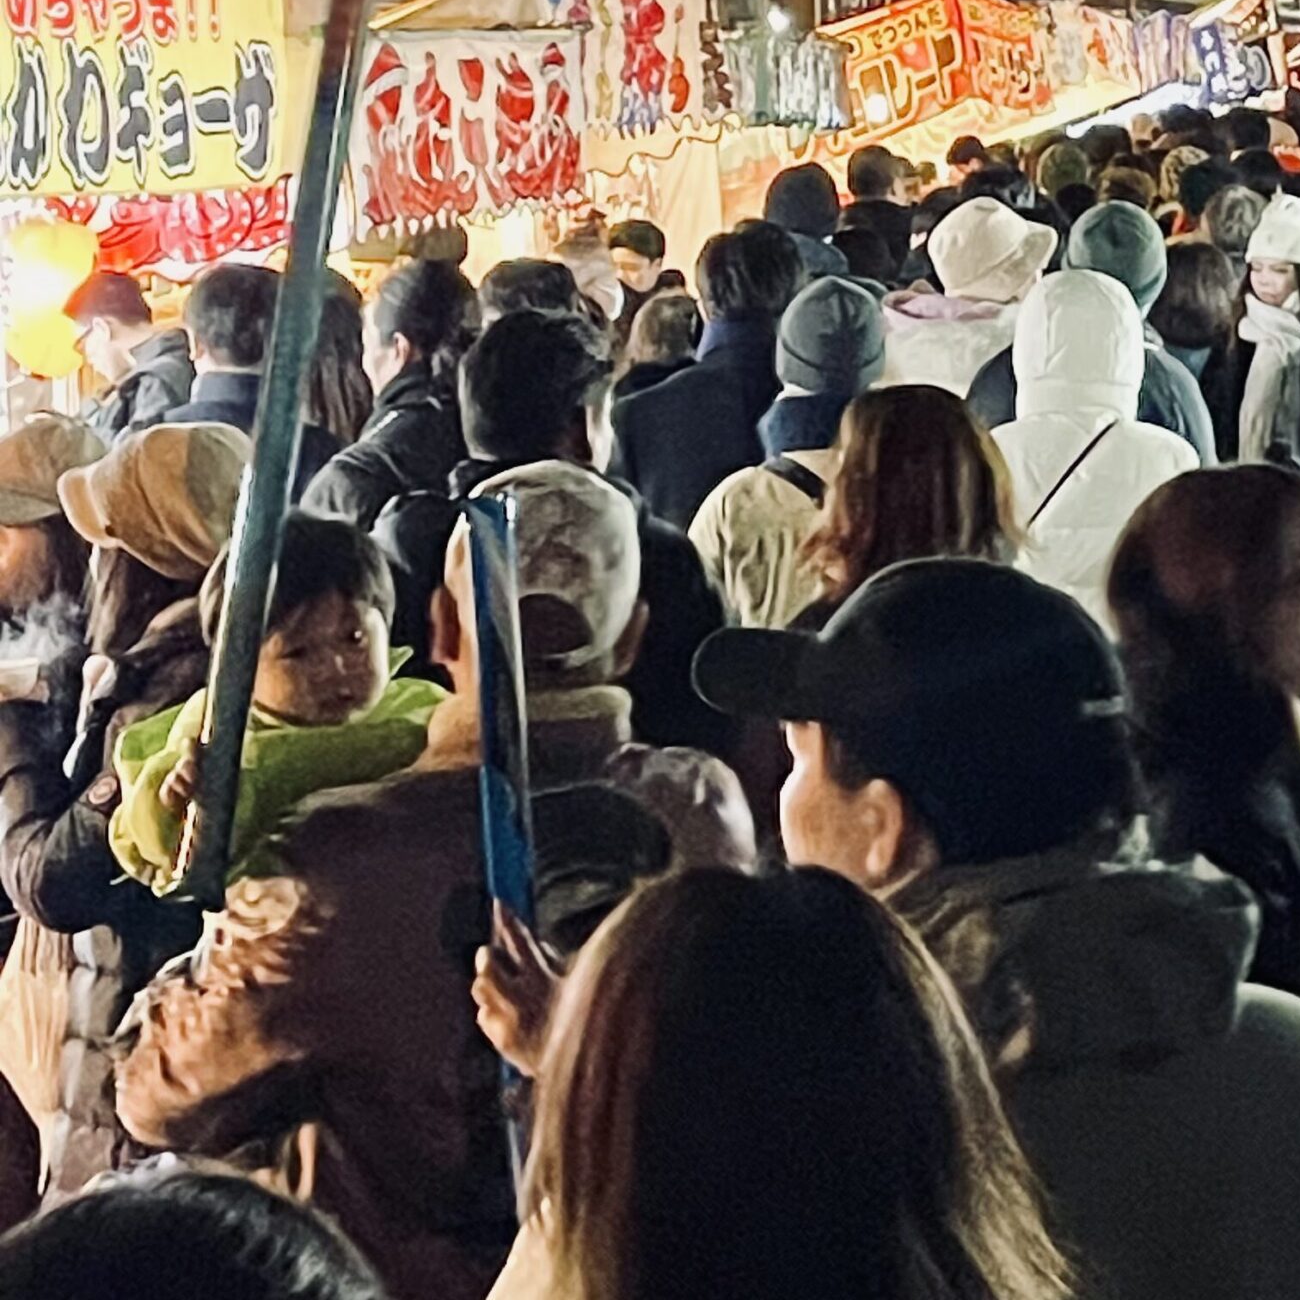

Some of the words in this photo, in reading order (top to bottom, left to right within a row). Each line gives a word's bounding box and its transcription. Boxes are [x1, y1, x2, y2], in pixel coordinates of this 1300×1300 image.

[0, 38, 275, 184] かわギョーザ
